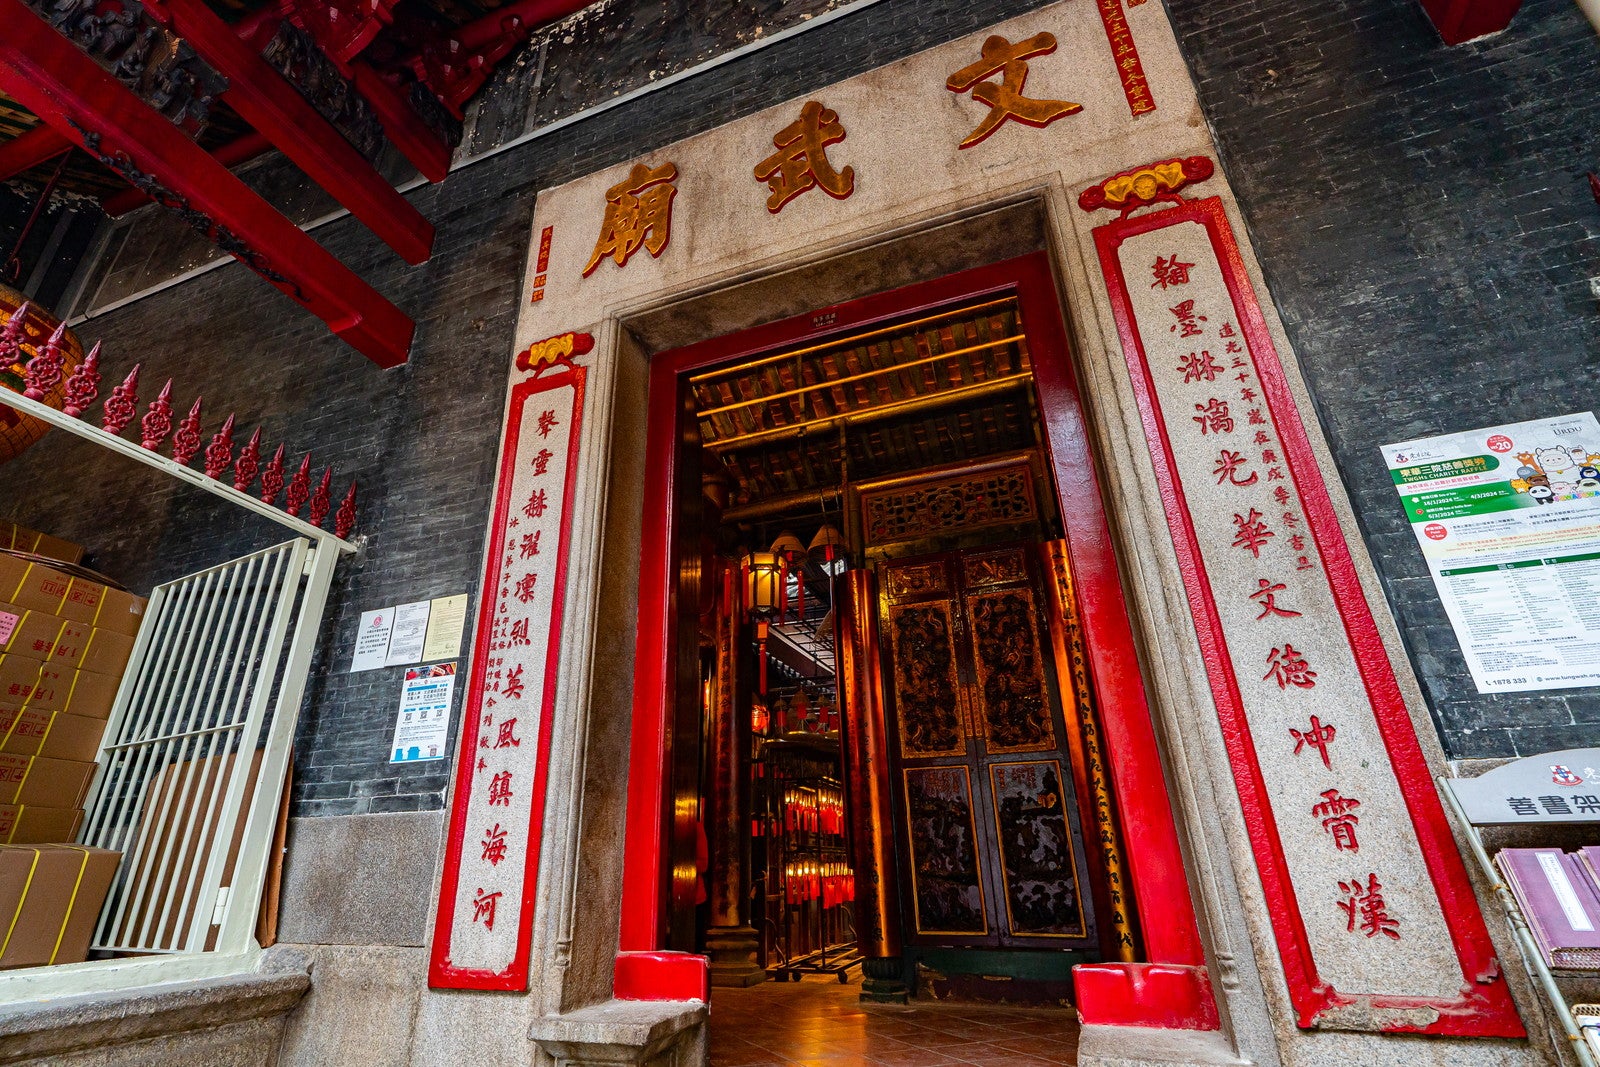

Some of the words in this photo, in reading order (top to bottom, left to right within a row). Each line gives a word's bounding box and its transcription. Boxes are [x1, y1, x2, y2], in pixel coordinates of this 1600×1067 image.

[582, 31, 1084, 278] 文武廟
[1403, 474, 1428, 483] TWGHs
[1429, 469, 1459, 479] CHARITY
[1461, 466, 1488, 475] RAFFLE
[1493, 678, 1511, 686] 1878
[1513, 677, 1528, 685] 333
[1506, 794, 1600, 816] 善書架
